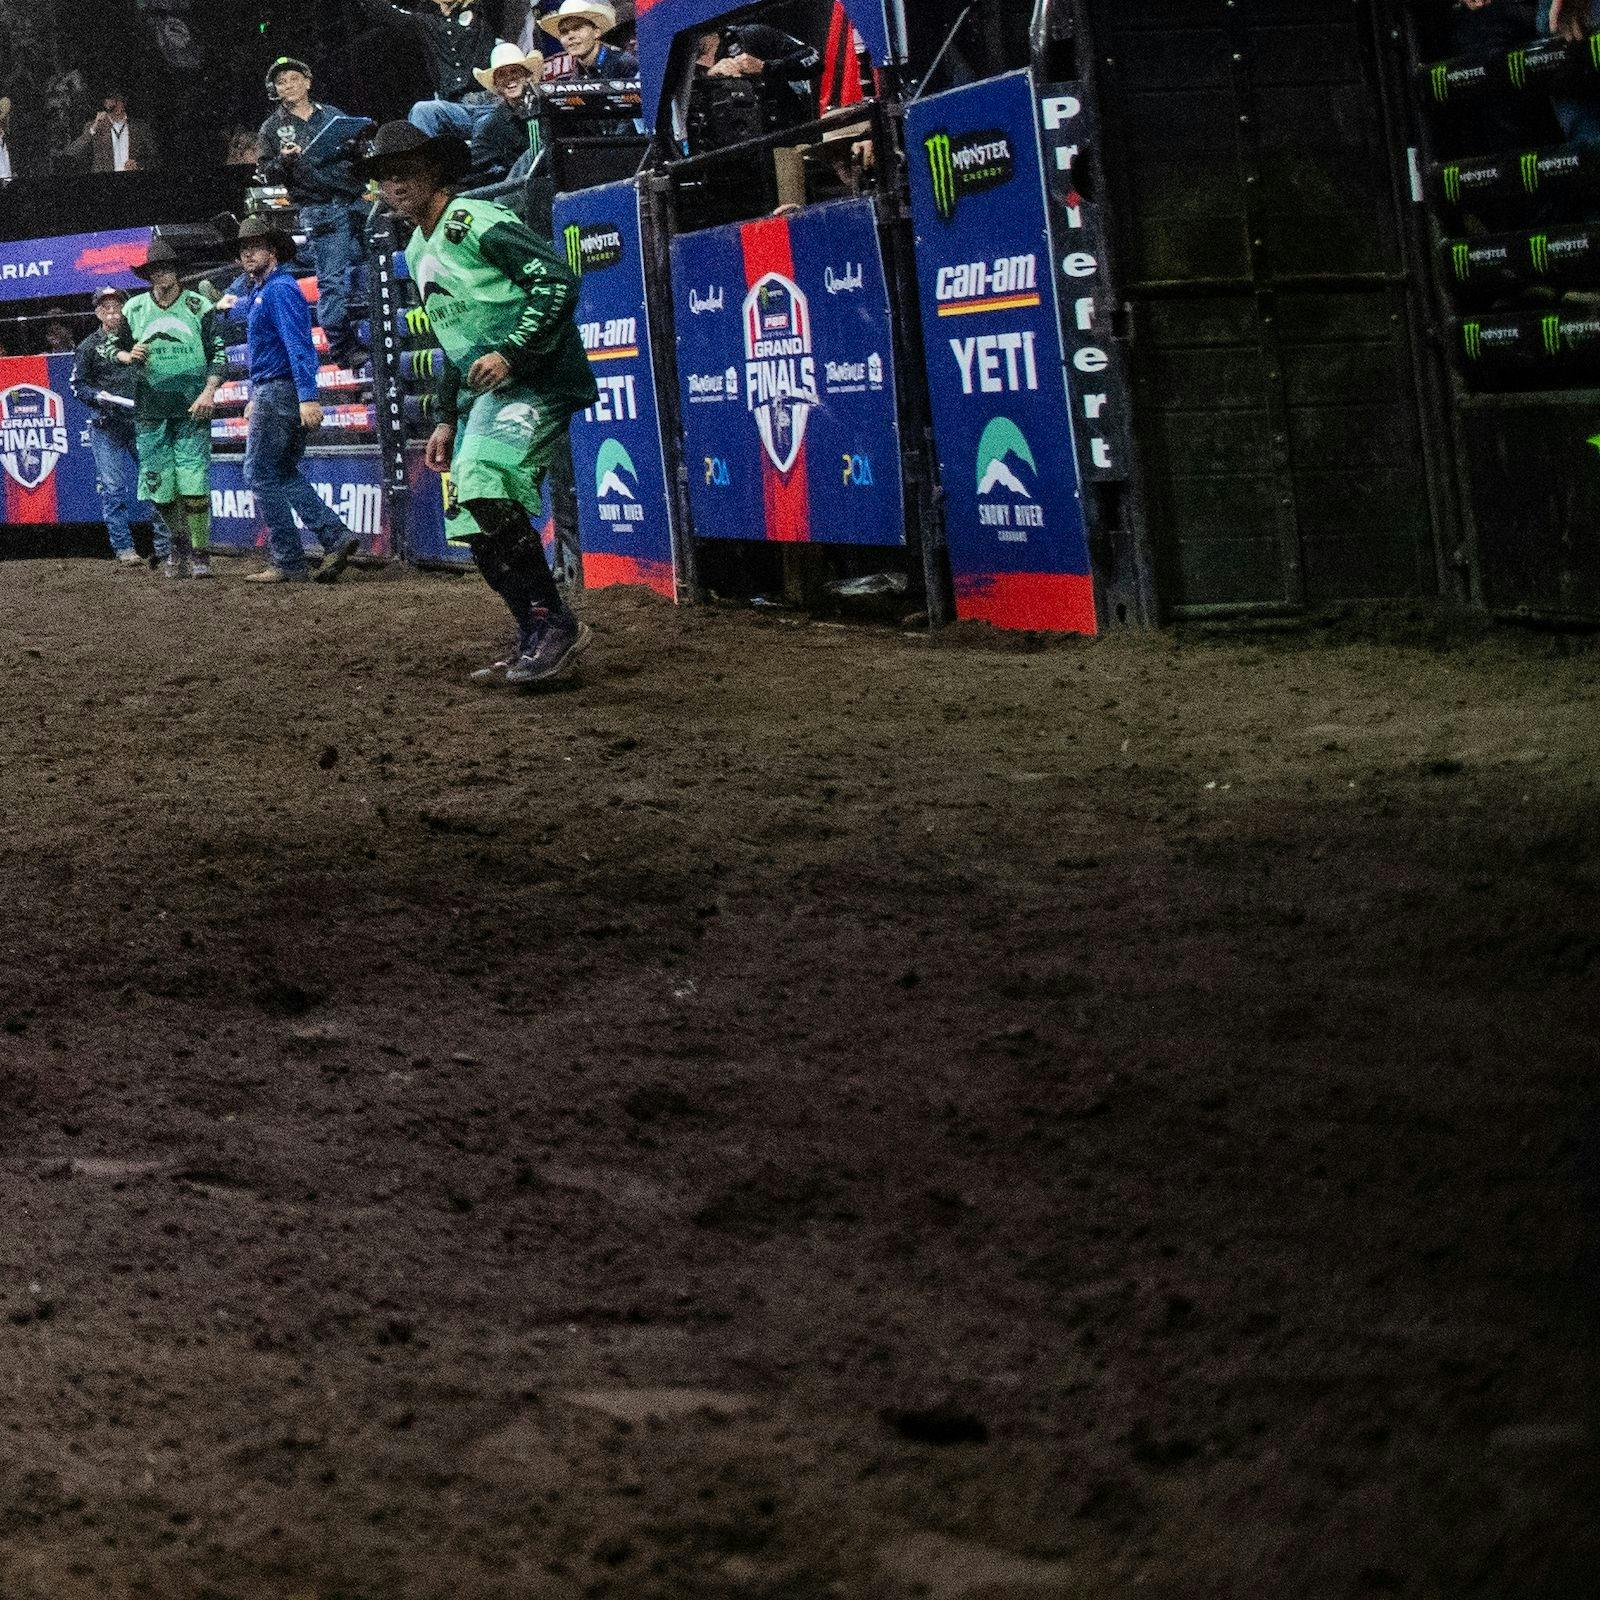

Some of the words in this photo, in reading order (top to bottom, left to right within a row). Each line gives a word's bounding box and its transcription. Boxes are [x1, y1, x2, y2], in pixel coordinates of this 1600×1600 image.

[556, 83, 602, 92] ARIAT
[952, 139, 1010, 171] MONSTER
[936, 253, 1037, 300] can-am
[1041, 96, 1112, 469] Priefert
[579, 317, 636, 349] an-am
[755, 338, 803, 357] GRAND
[950, 331, 1038, 394] YETI
[746, 357, 820, 411] FINALS
[1, 417, 55, 428] GRAND
[210, 489, 255, 519] RAM
[290, 483, 382, 534] n-am
